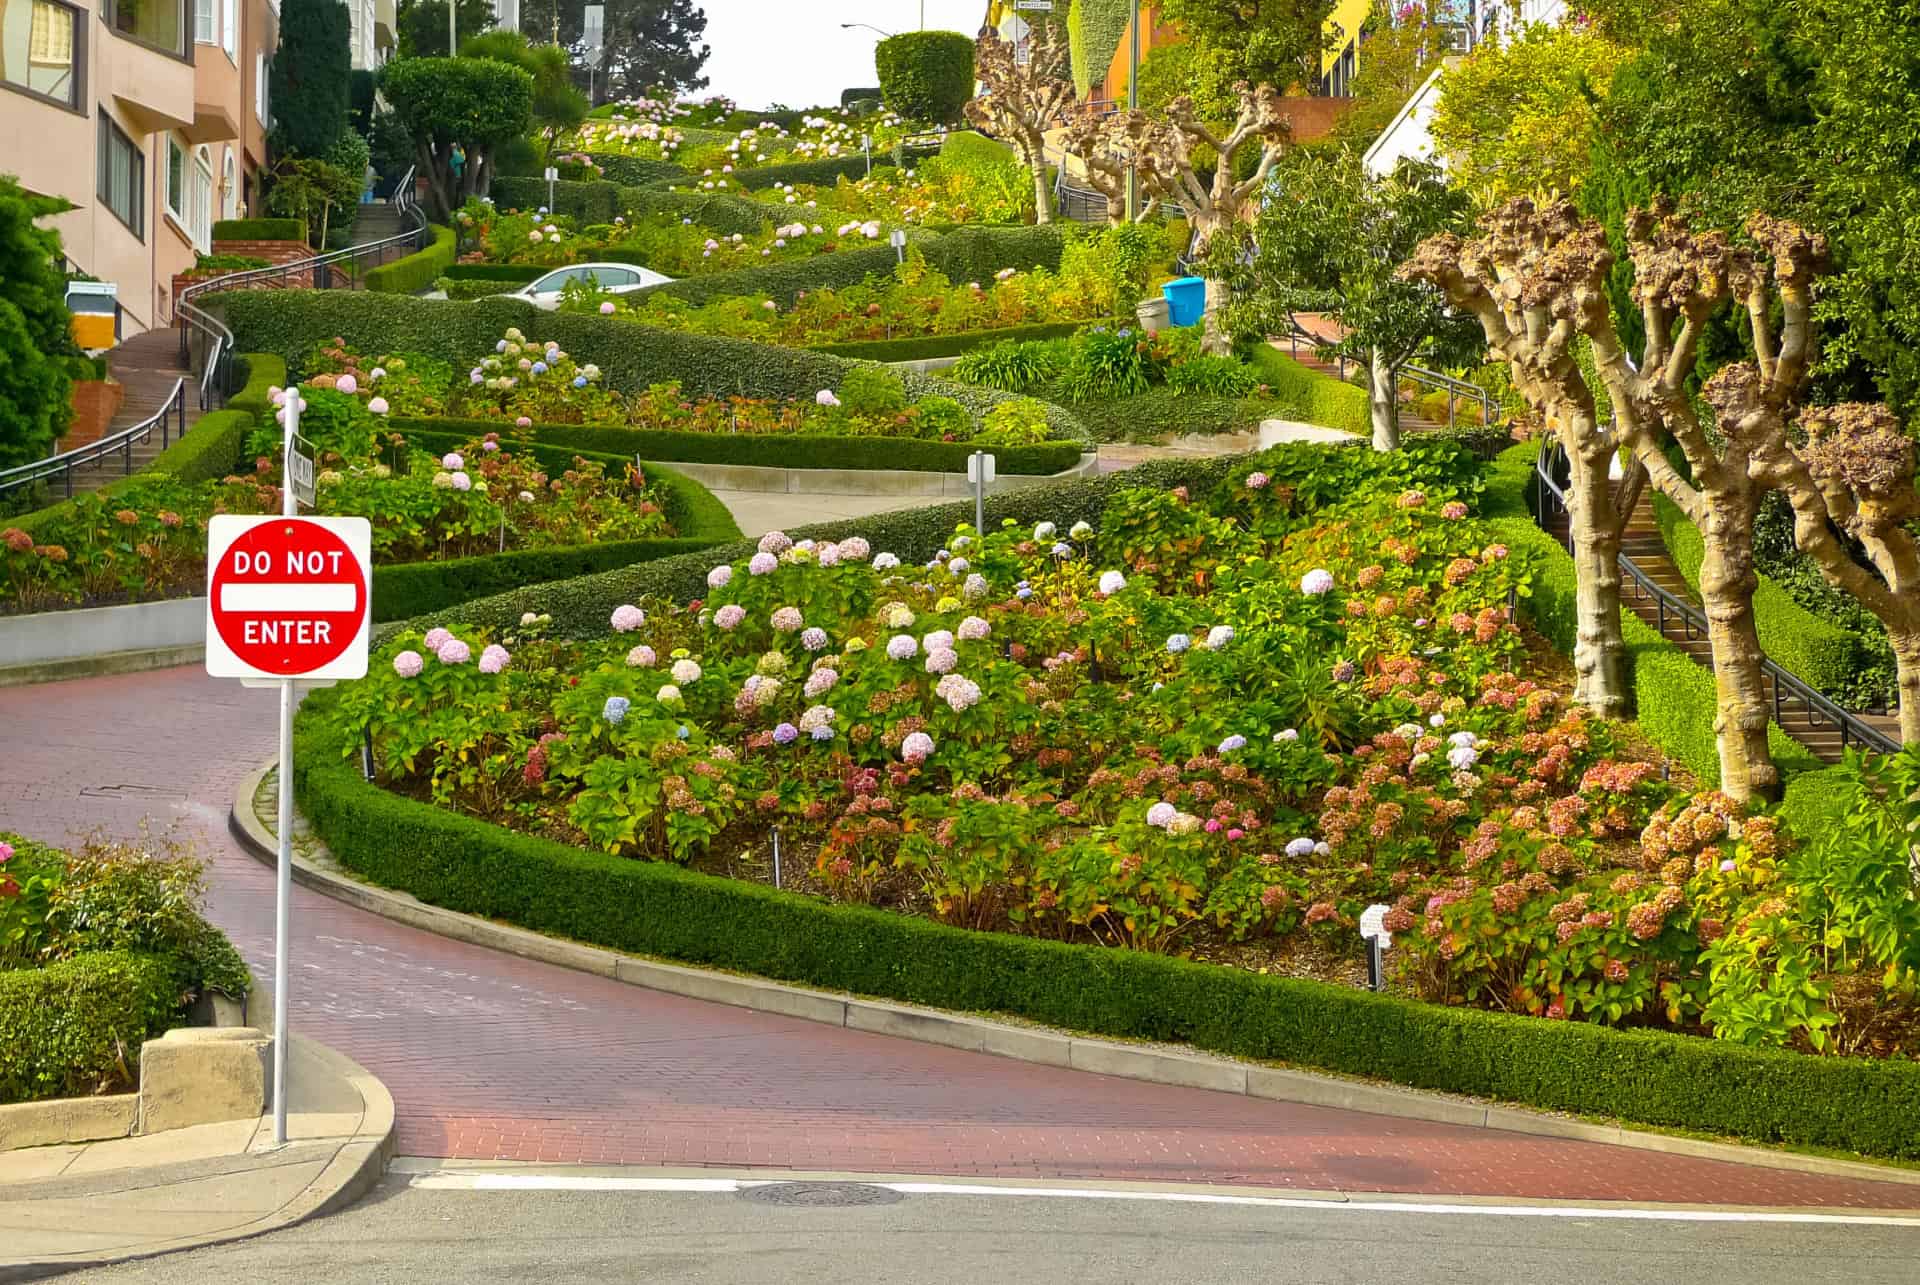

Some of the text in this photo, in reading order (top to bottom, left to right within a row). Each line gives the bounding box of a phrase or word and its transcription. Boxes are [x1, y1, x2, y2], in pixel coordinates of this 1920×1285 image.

[234, 551, 343, 575] DO NOT
[244, 620, 331, 644] ENTER
